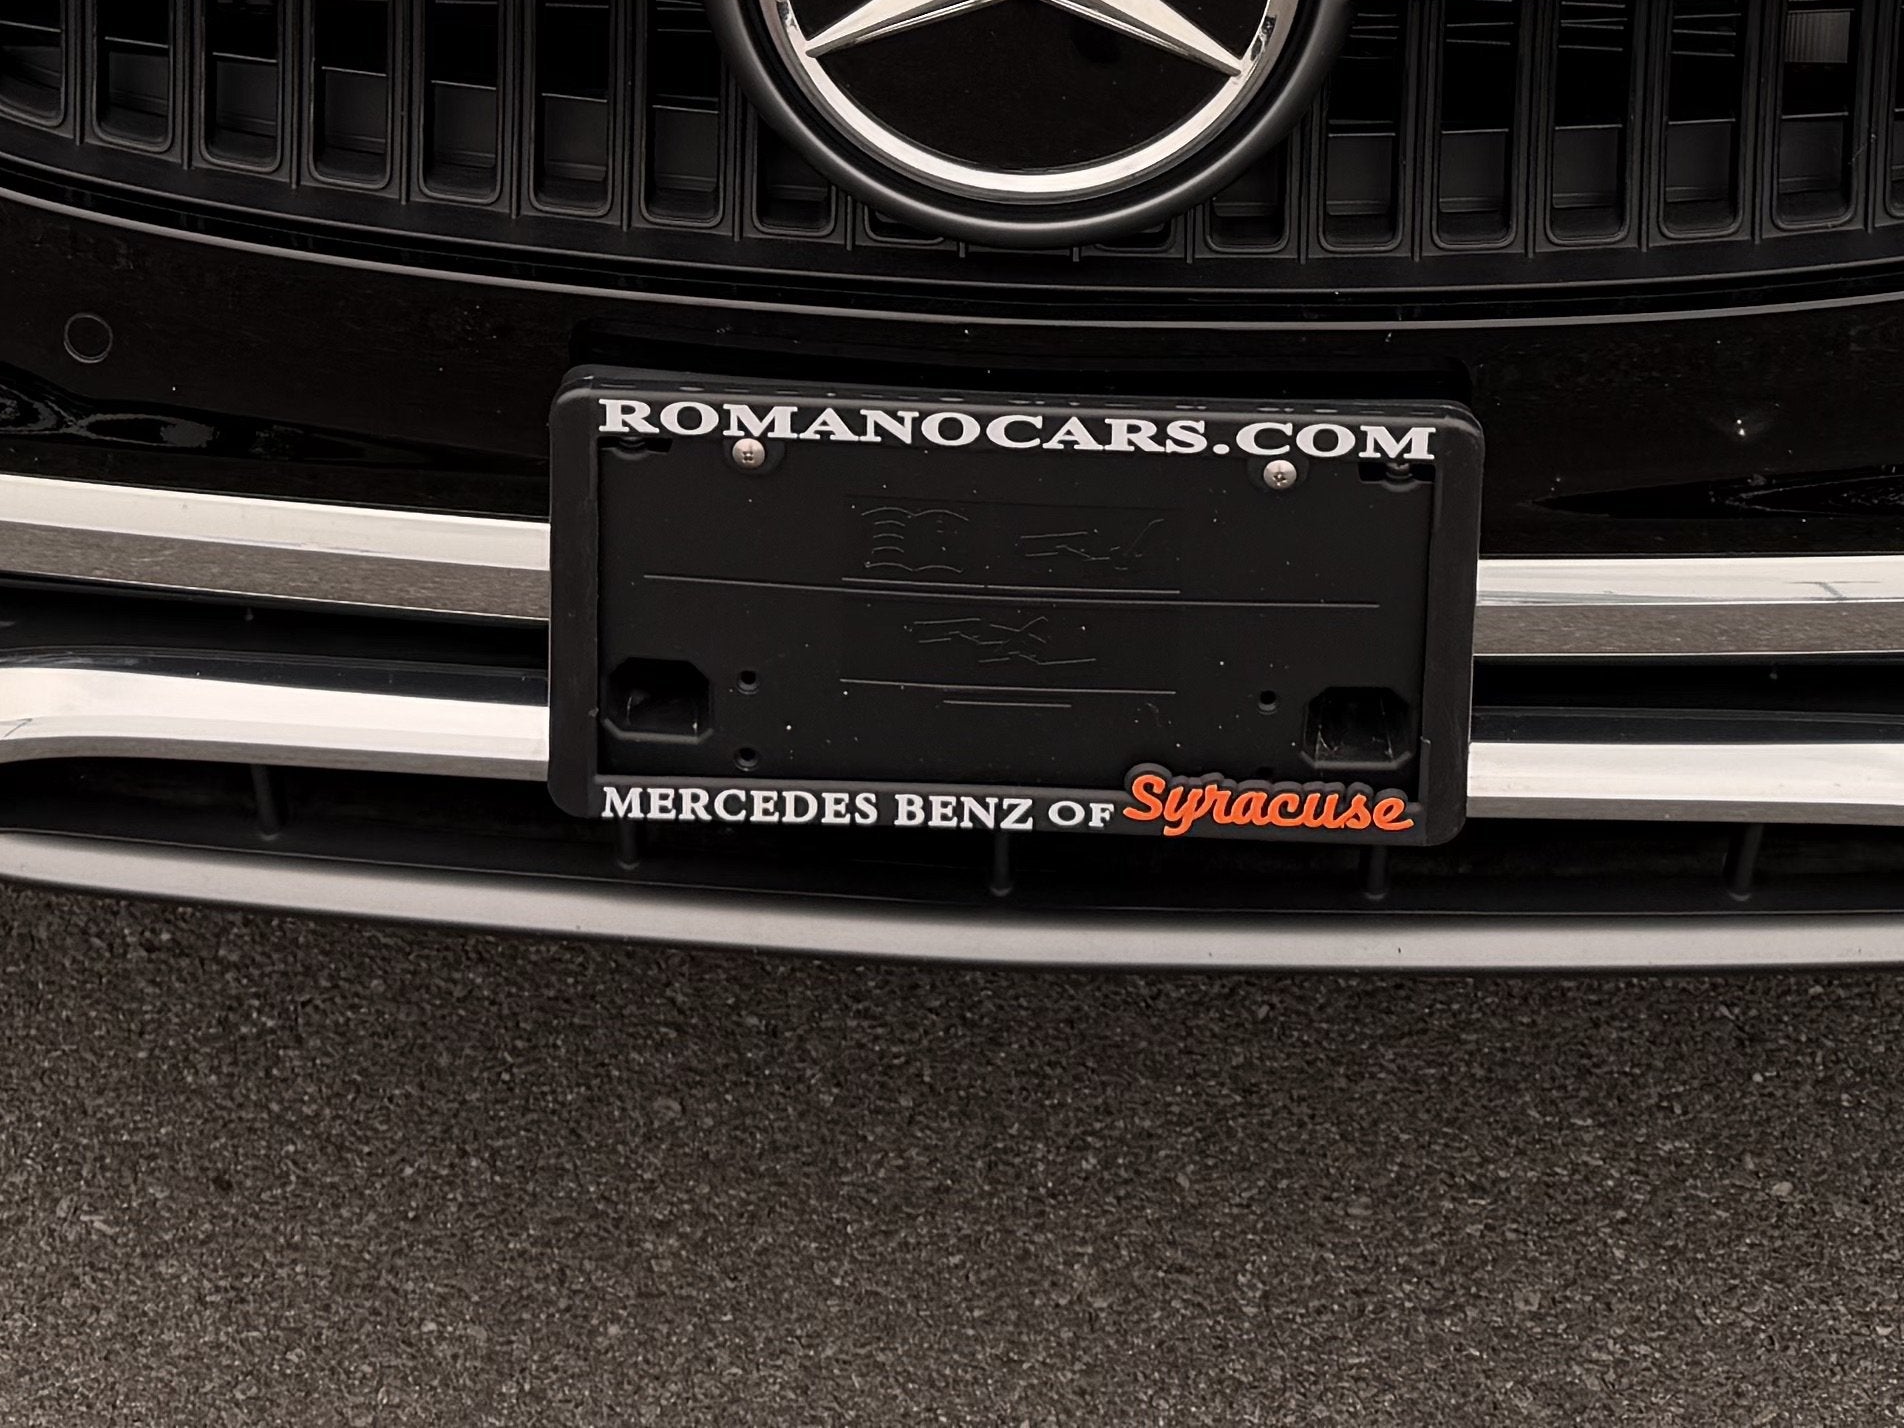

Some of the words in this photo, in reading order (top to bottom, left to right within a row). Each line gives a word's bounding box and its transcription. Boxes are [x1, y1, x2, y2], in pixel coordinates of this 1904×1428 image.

[598, 398, 1437, 460] ROMANOCARS.COM
[601, 785, 878, 825] MERCEDES
[893, 792, 1034, 830] BENZ
[1047, 799, 1115, 828] OF
[1123, 774, 1414, 837] Syracuse
